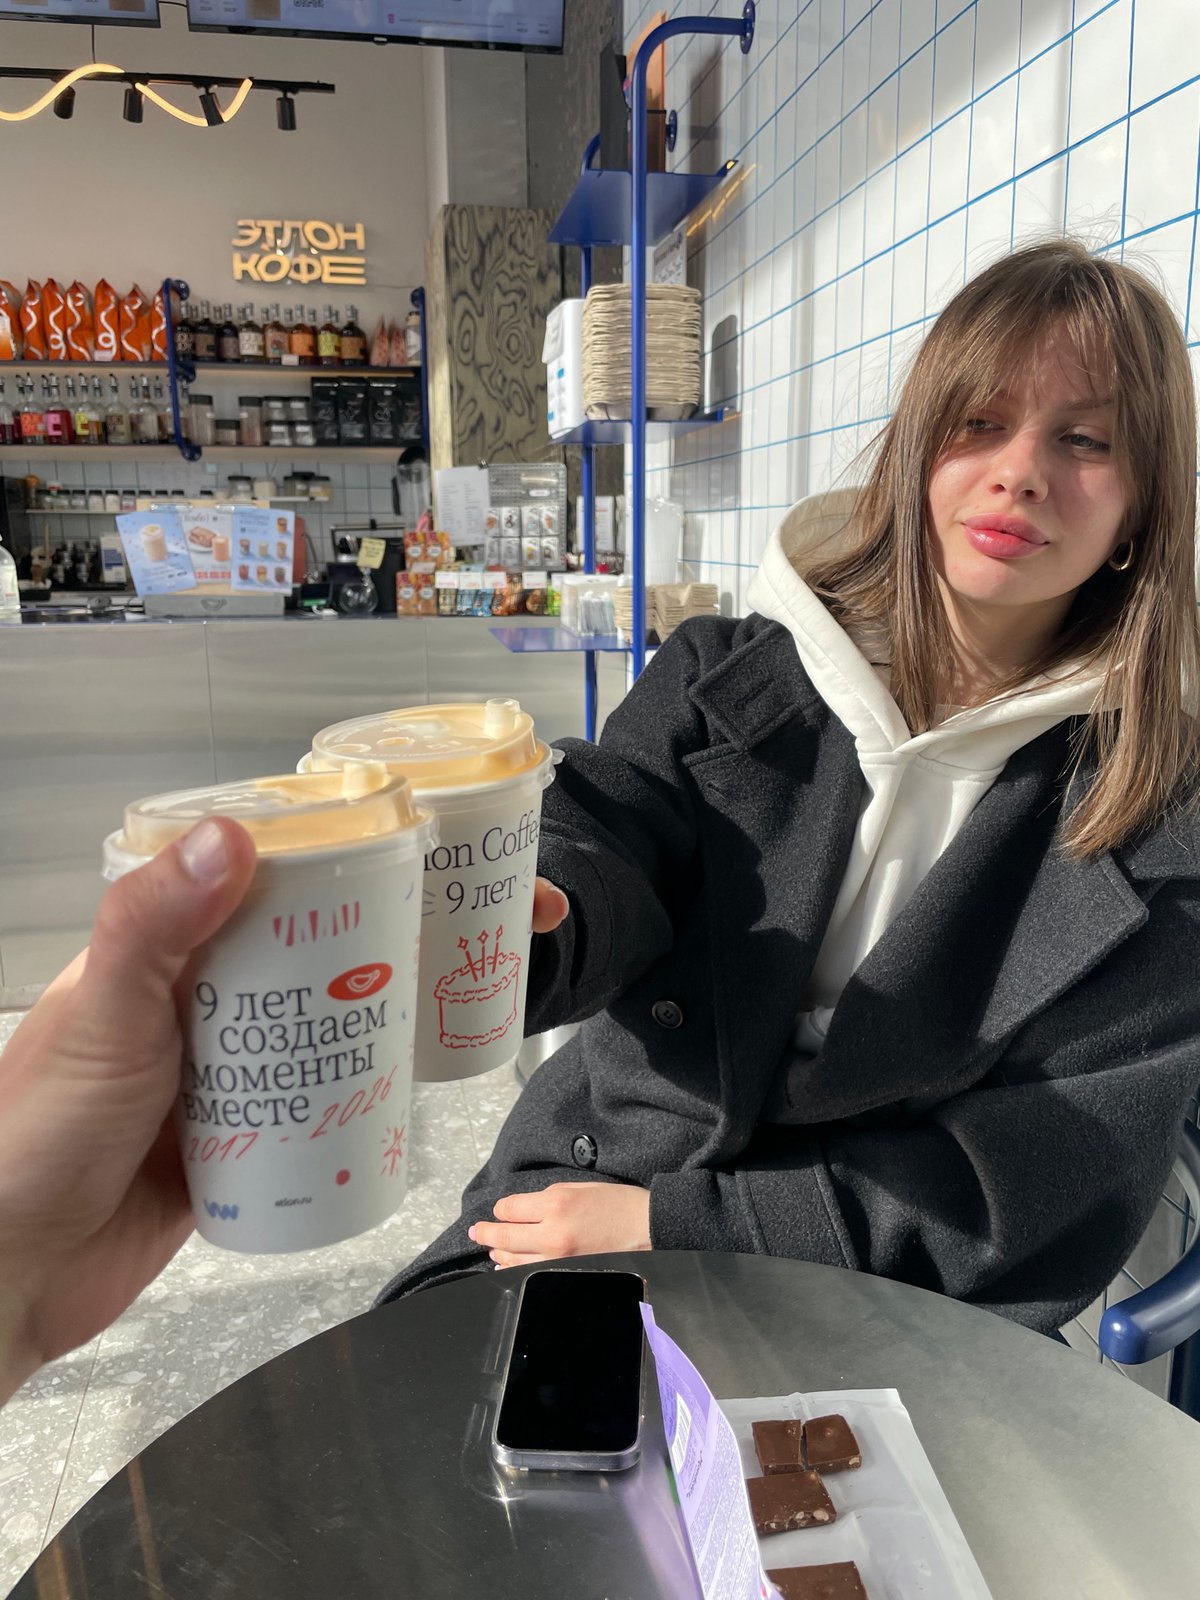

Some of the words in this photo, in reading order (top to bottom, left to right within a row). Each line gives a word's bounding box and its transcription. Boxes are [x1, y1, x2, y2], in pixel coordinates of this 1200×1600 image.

[231, 218, 366, 250] ЭТЛОН
[232, 252, 367, 285] КОФЕ
[446, 881, 465, 914] 9
[471, 875, 517, 910] лет
[196, 981, 218, 1022] 9
[234, 987, 312, 1022] лет
[219, 1000, 388, 1058] создаем
[188, 1042, 375, 1094] моменты
[179, 1092, 311, 1128] вместе
[187, 1131, 259, 1163] 2017
[309, 1064, 399, 1140] 2026
